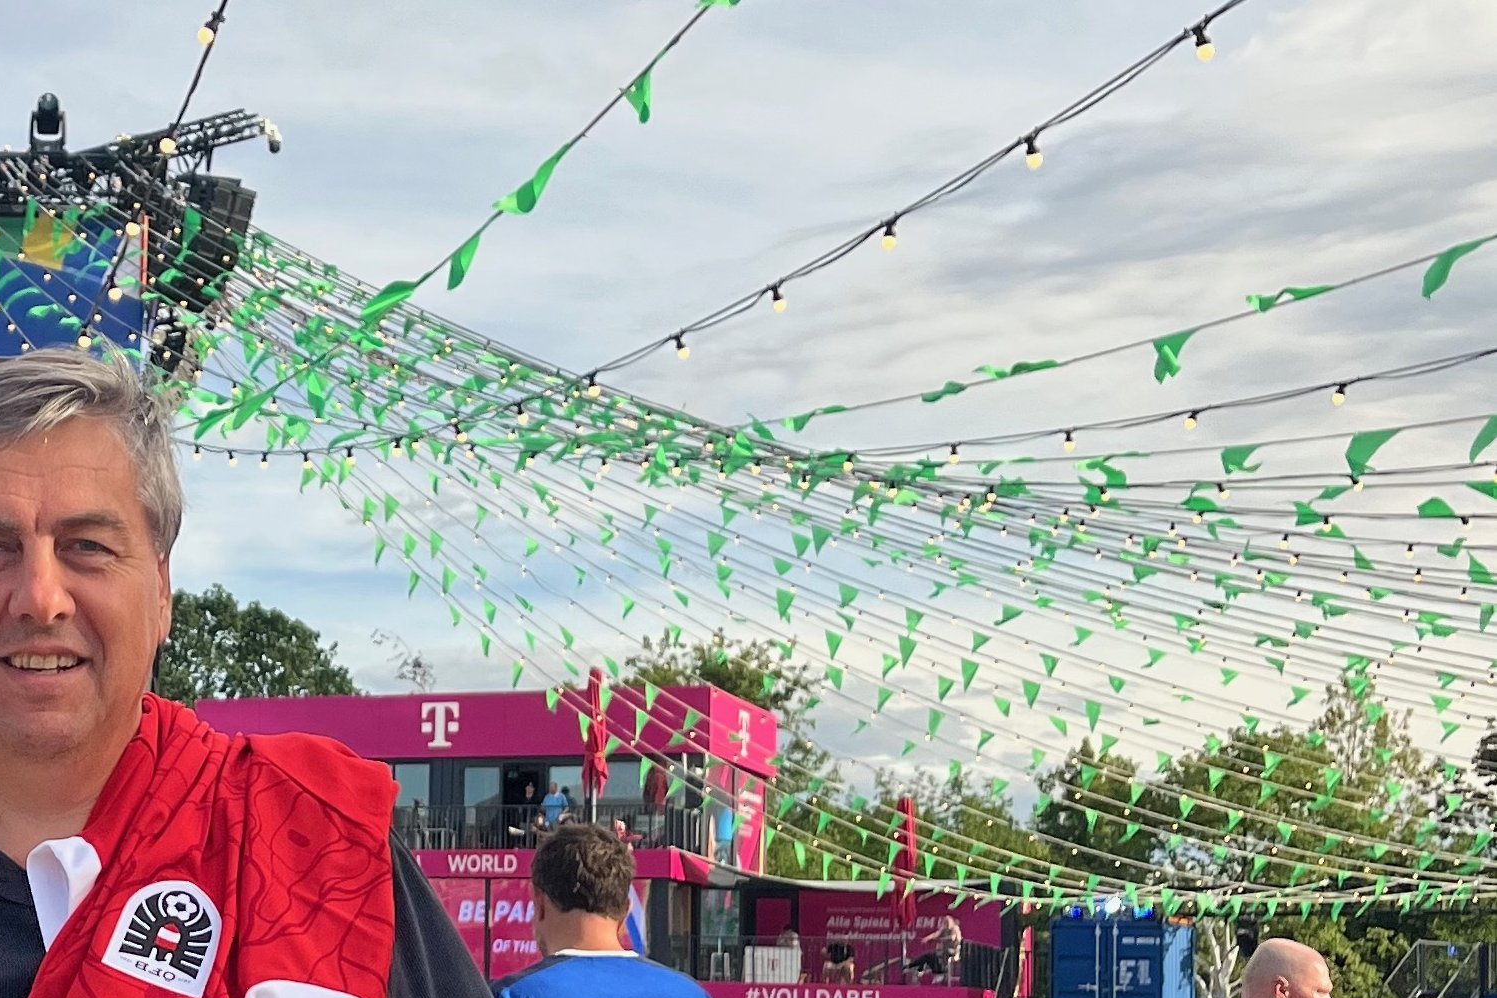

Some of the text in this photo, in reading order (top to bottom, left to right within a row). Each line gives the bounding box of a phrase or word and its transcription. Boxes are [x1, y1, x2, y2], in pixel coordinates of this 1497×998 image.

[447, 854, 517, 873] WORLD
[492, 939, 538, 953] OF THE
